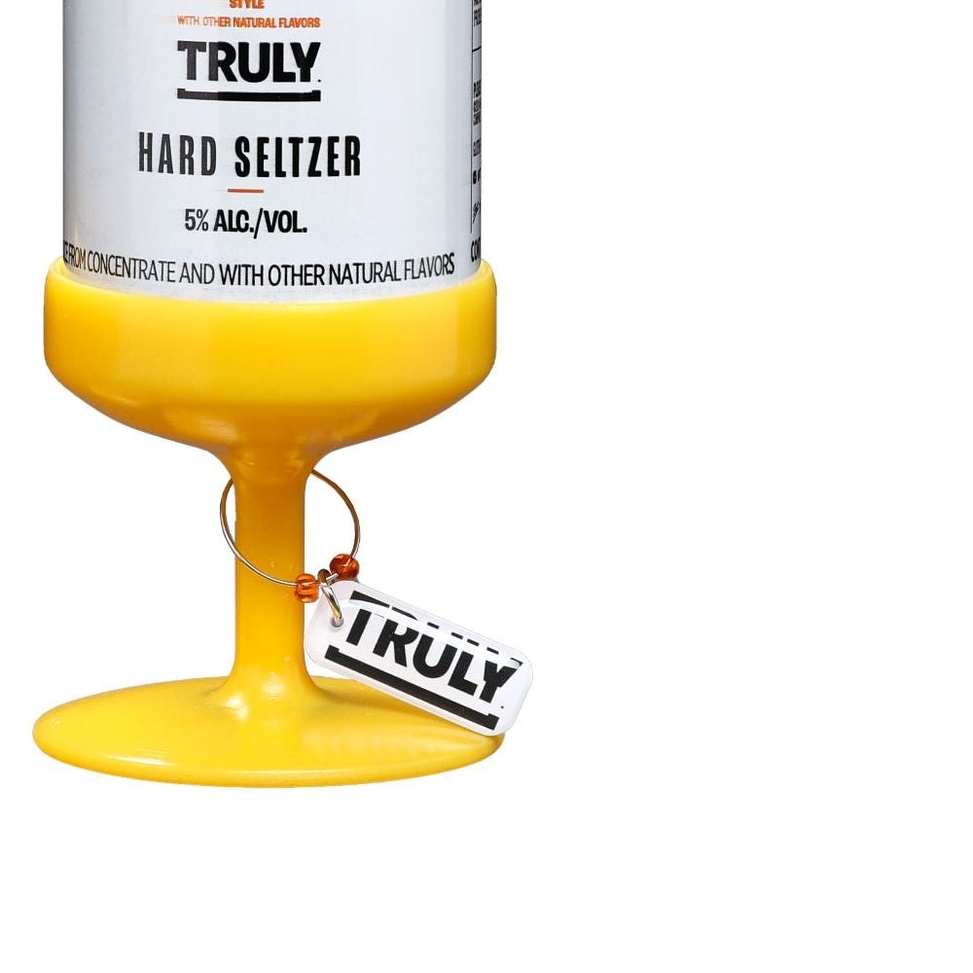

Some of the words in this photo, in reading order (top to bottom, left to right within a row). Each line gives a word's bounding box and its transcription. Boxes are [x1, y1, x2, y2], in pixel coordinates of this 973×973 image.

[177, 16, 200, 26] WITH
[203, 16, 231, 27] OTHER
[233, 16, 276, 28] NATURAL
[279, 16, 321, 28] FLAVORS
[177, 40, 320, 83] TRULY
[139, 132, 217, 176] HARD
[235, 135, 361, 178] SELTZER
[185, 208, 209, 232] 5%
[213, 208, 308, 239] ALC./VOL.
[68, 244, 86, 270] FROM
[87, 250, 176, 283] CONCENTRATE
[180, 262, 215, 284] AND
[219, 264, 264, 286] WITH
[267, 261, 326, 286] OTHER
[329, 259, 401, 285] NATURAL
[403, 252, 455, 280] FLAVORS
[346, 590, 524, 703] TRULY
